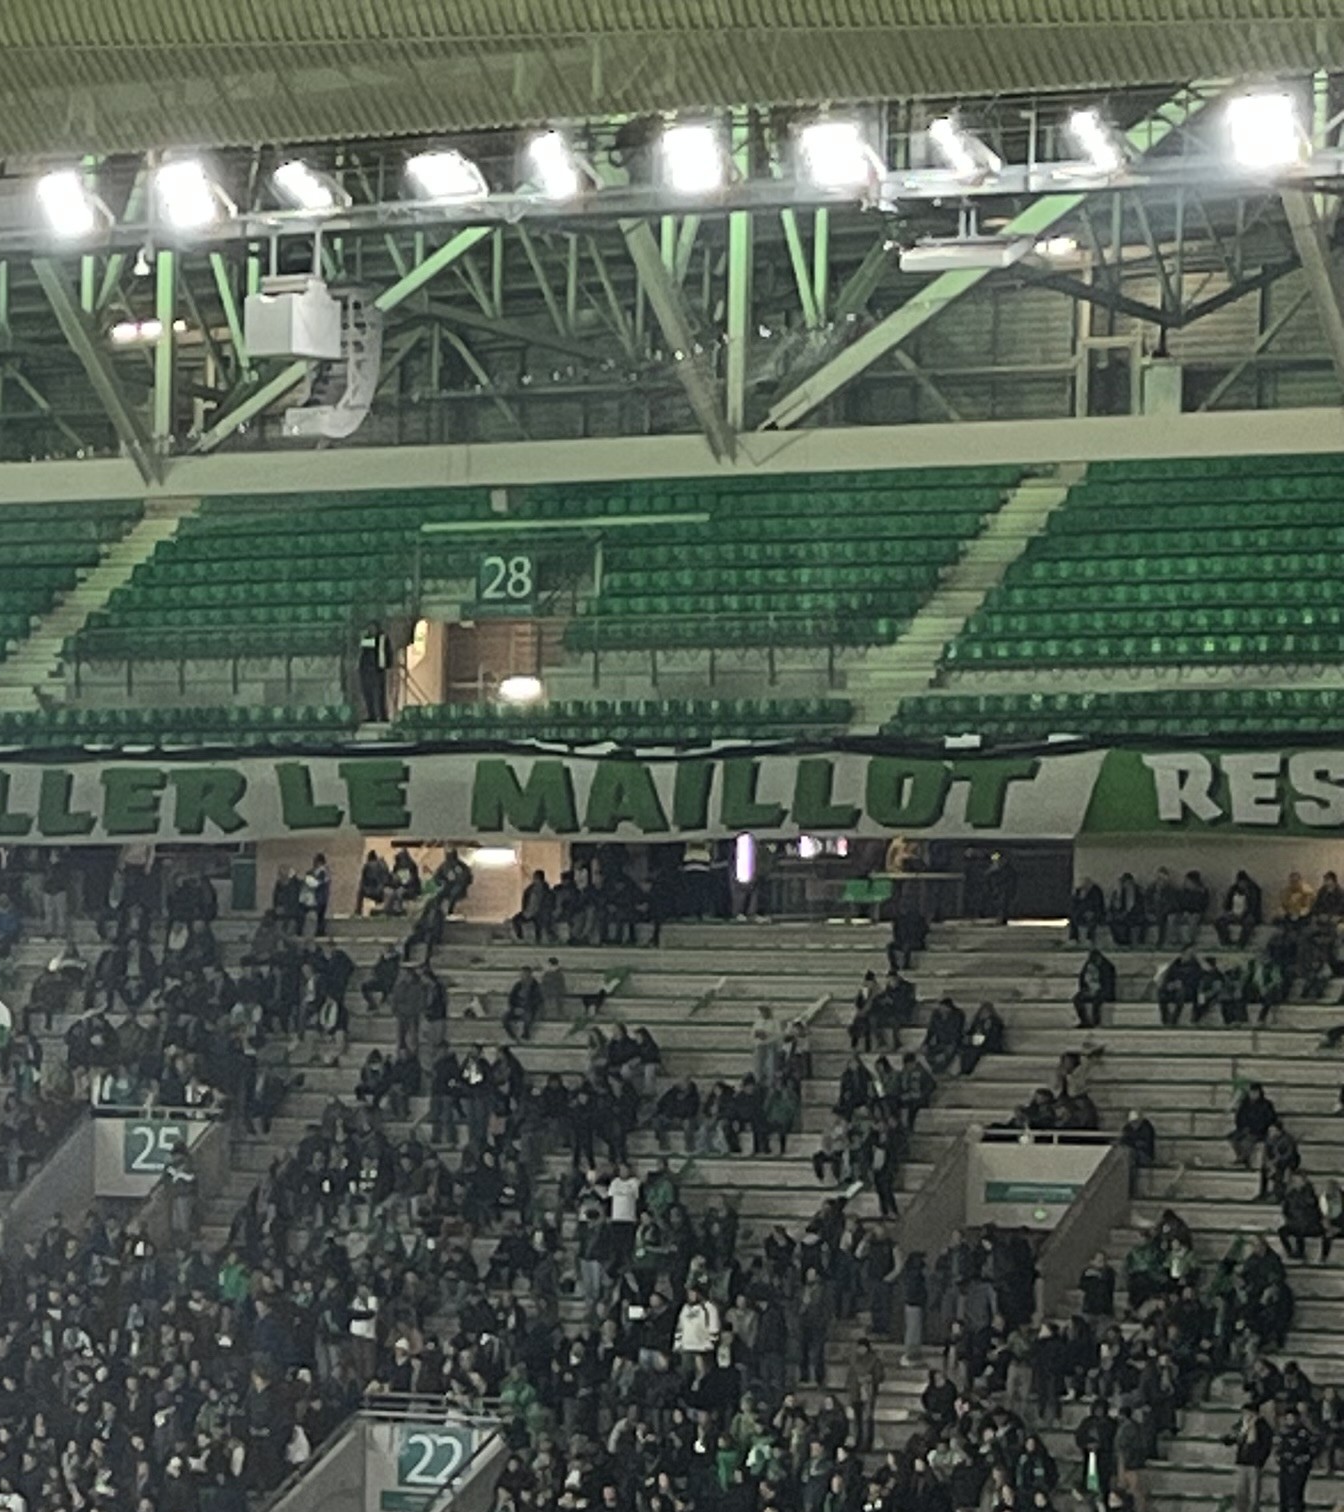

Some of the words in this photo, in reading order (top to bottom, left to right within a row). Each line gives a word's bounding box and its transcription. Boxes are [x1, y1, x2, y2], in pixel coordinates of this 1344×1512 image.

[481, 556, 532, 598] 28
[274, 760, 410, 830] LE
[468, 760, 1039, 832] MAILLOT
[405, 1433, 462, 1485] 22
